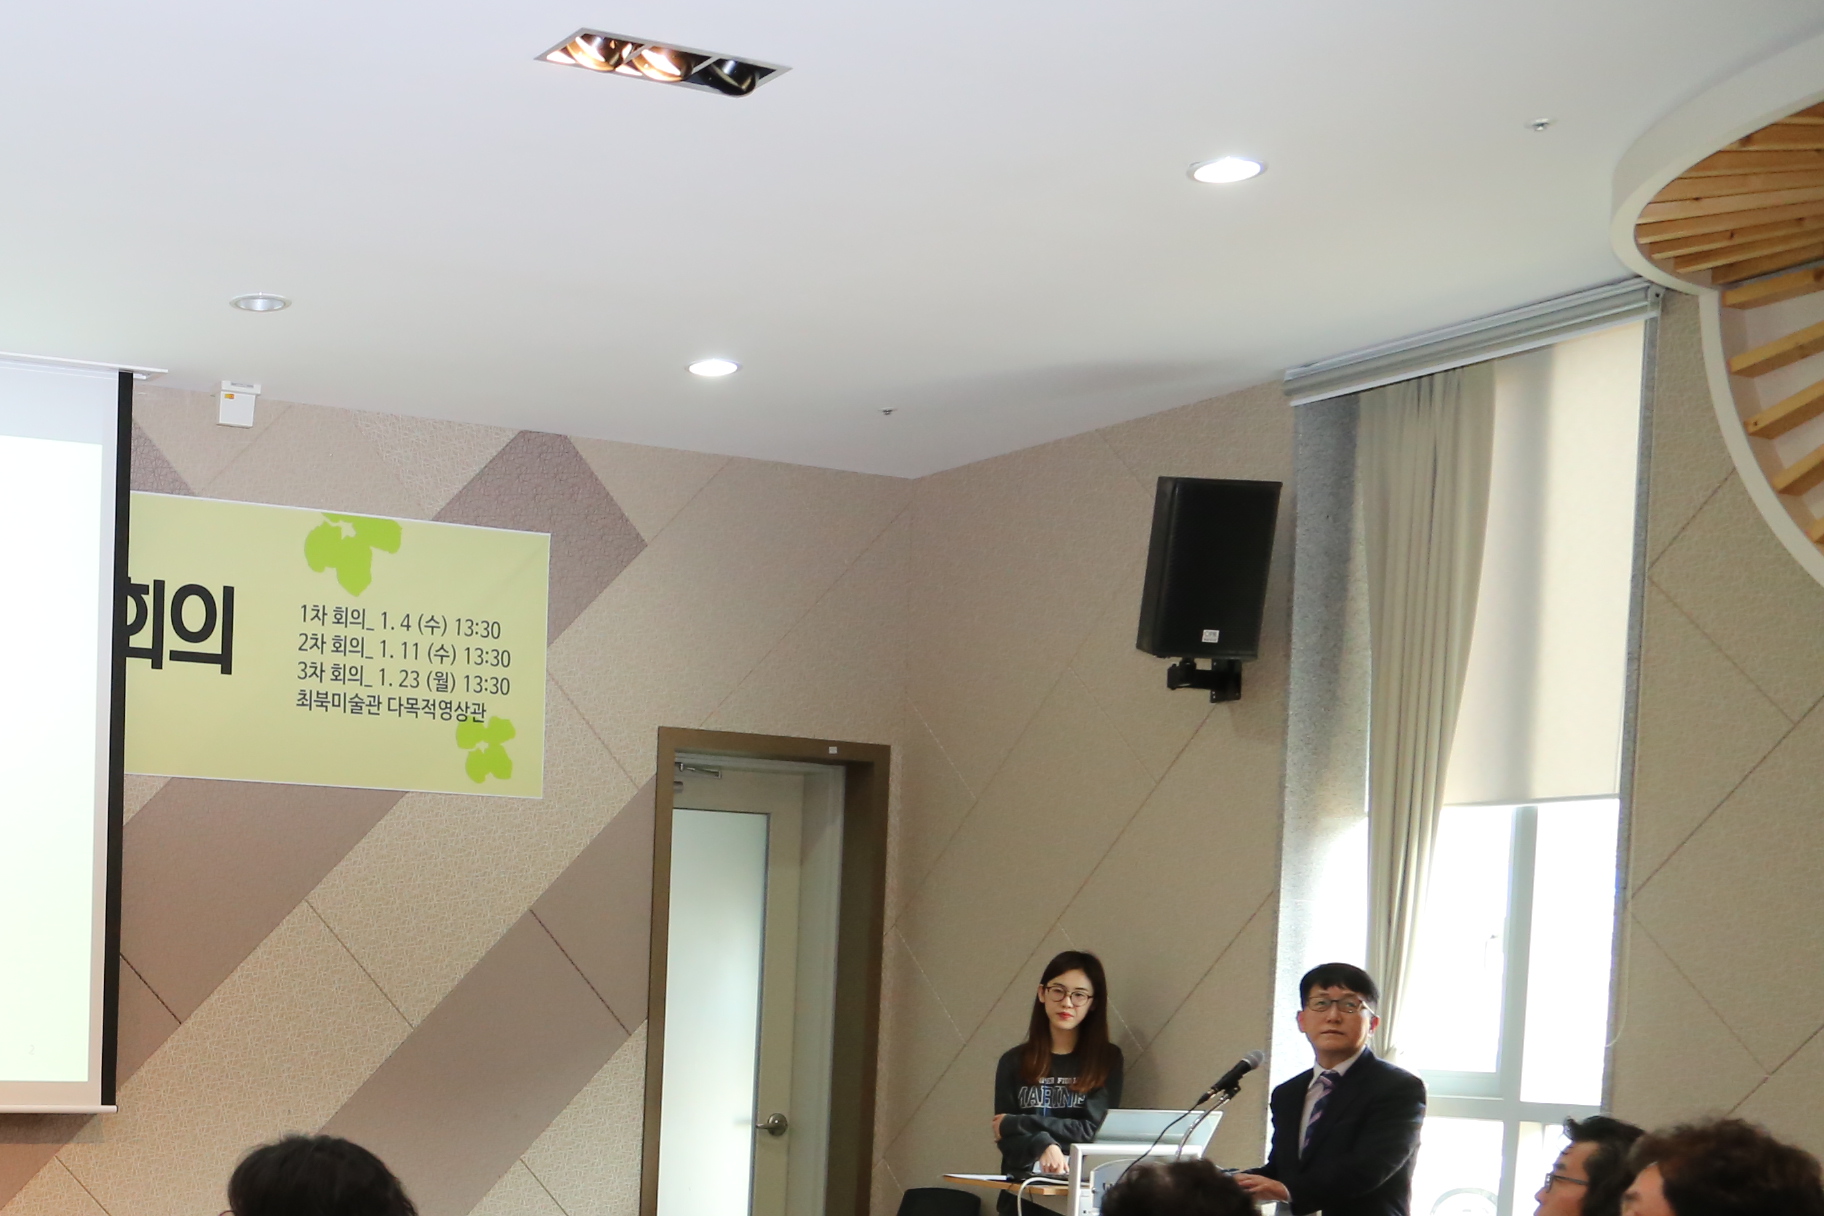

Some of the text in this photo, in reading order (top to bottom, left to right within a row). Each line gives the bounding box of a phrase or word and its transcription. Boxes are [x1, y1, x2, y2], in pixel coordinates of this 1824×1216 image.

[126, 576, 235, 675] 회의
[300, 603, 328, 626] 1차
[380, 611, 395, 631] 1.
[400, 613, 412, 632] 4
[417, 613, 448, 637] (수)
[455, 617, 502, 640] 13:30
[297, 632, 327, 655] 2차
[379, 639, 394, 659] 1.
[401, 641, 420, 661] 11
[427, 642, 457, 666] (수)
[464, 646, 512, 669] 13:30
[296, 661, 326, 684] 3차
[378, 667, 393, 687] 1.
[398, 669, 421, 689] 23
[426, 670, 456, 694] (월)
[463, 674, 511, 696] 13:30
[296, 689, 488, 723] 최북미술관 다목적영상관
